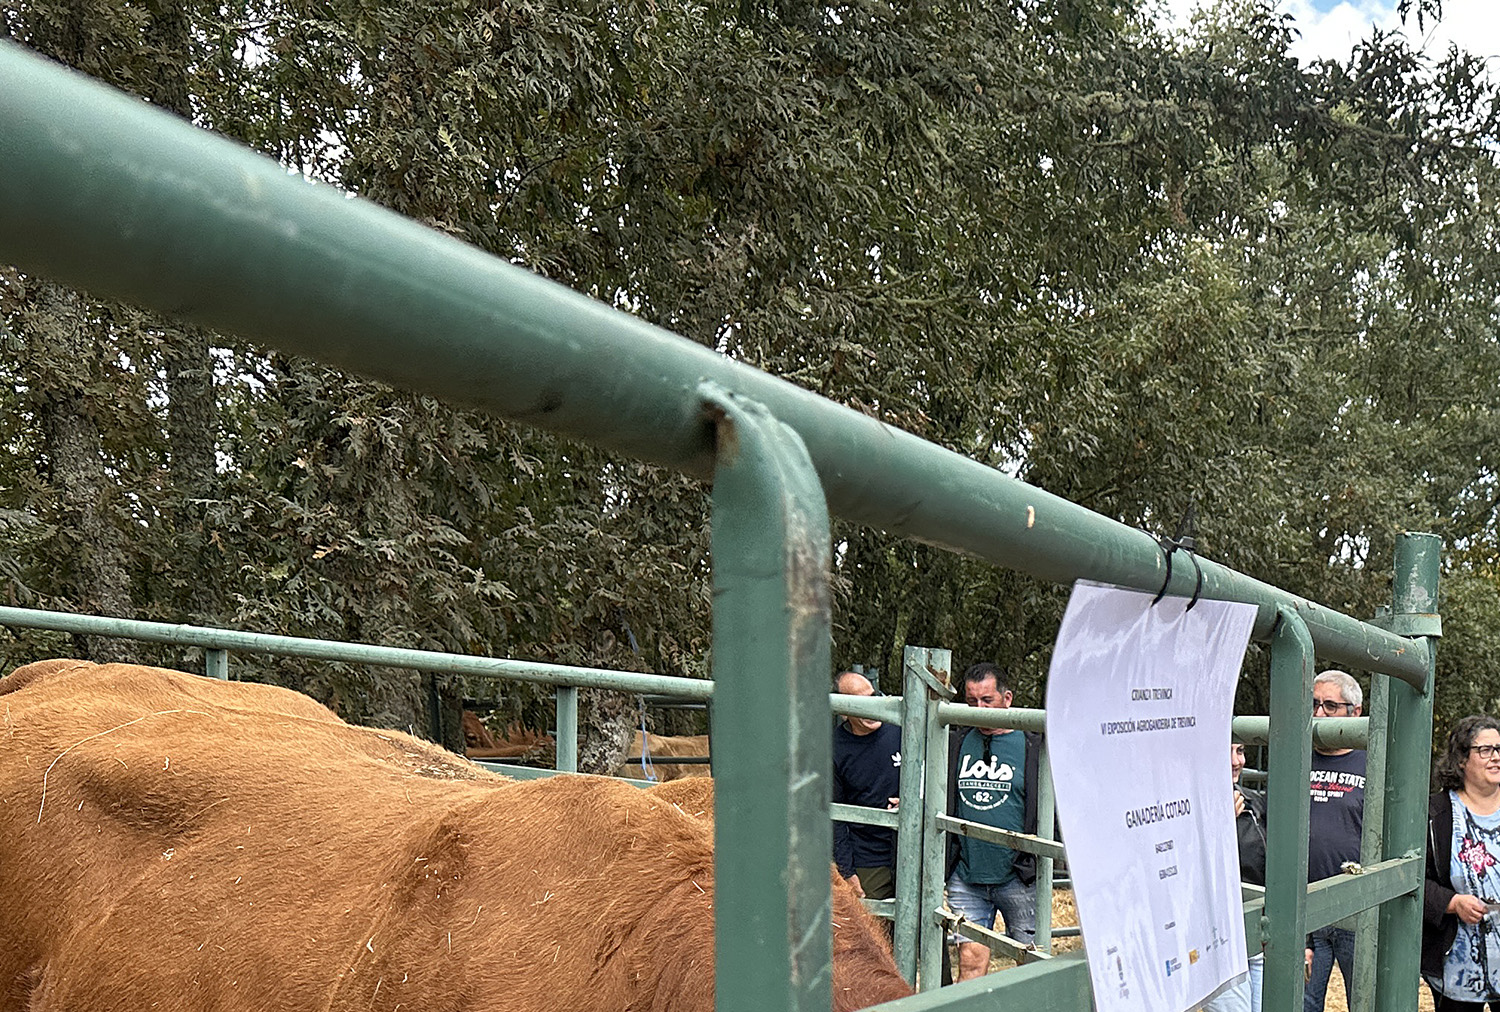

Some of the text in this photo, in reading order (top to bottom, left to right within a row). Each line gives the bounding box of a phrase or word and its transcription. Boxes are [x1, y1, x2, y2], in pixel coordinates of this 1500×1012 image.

[1107, 717, 1136, 735] EXPOSICIÓN
[1171, 717, 1177, 729] DE
[959, 754, 1013, 781] Lois
[1310, 770, 1366, 789] OCEAN STATE
[975, 791, 990, 803] 62
[1125, 799, 1191, 829] GANADERÍA COTADO
